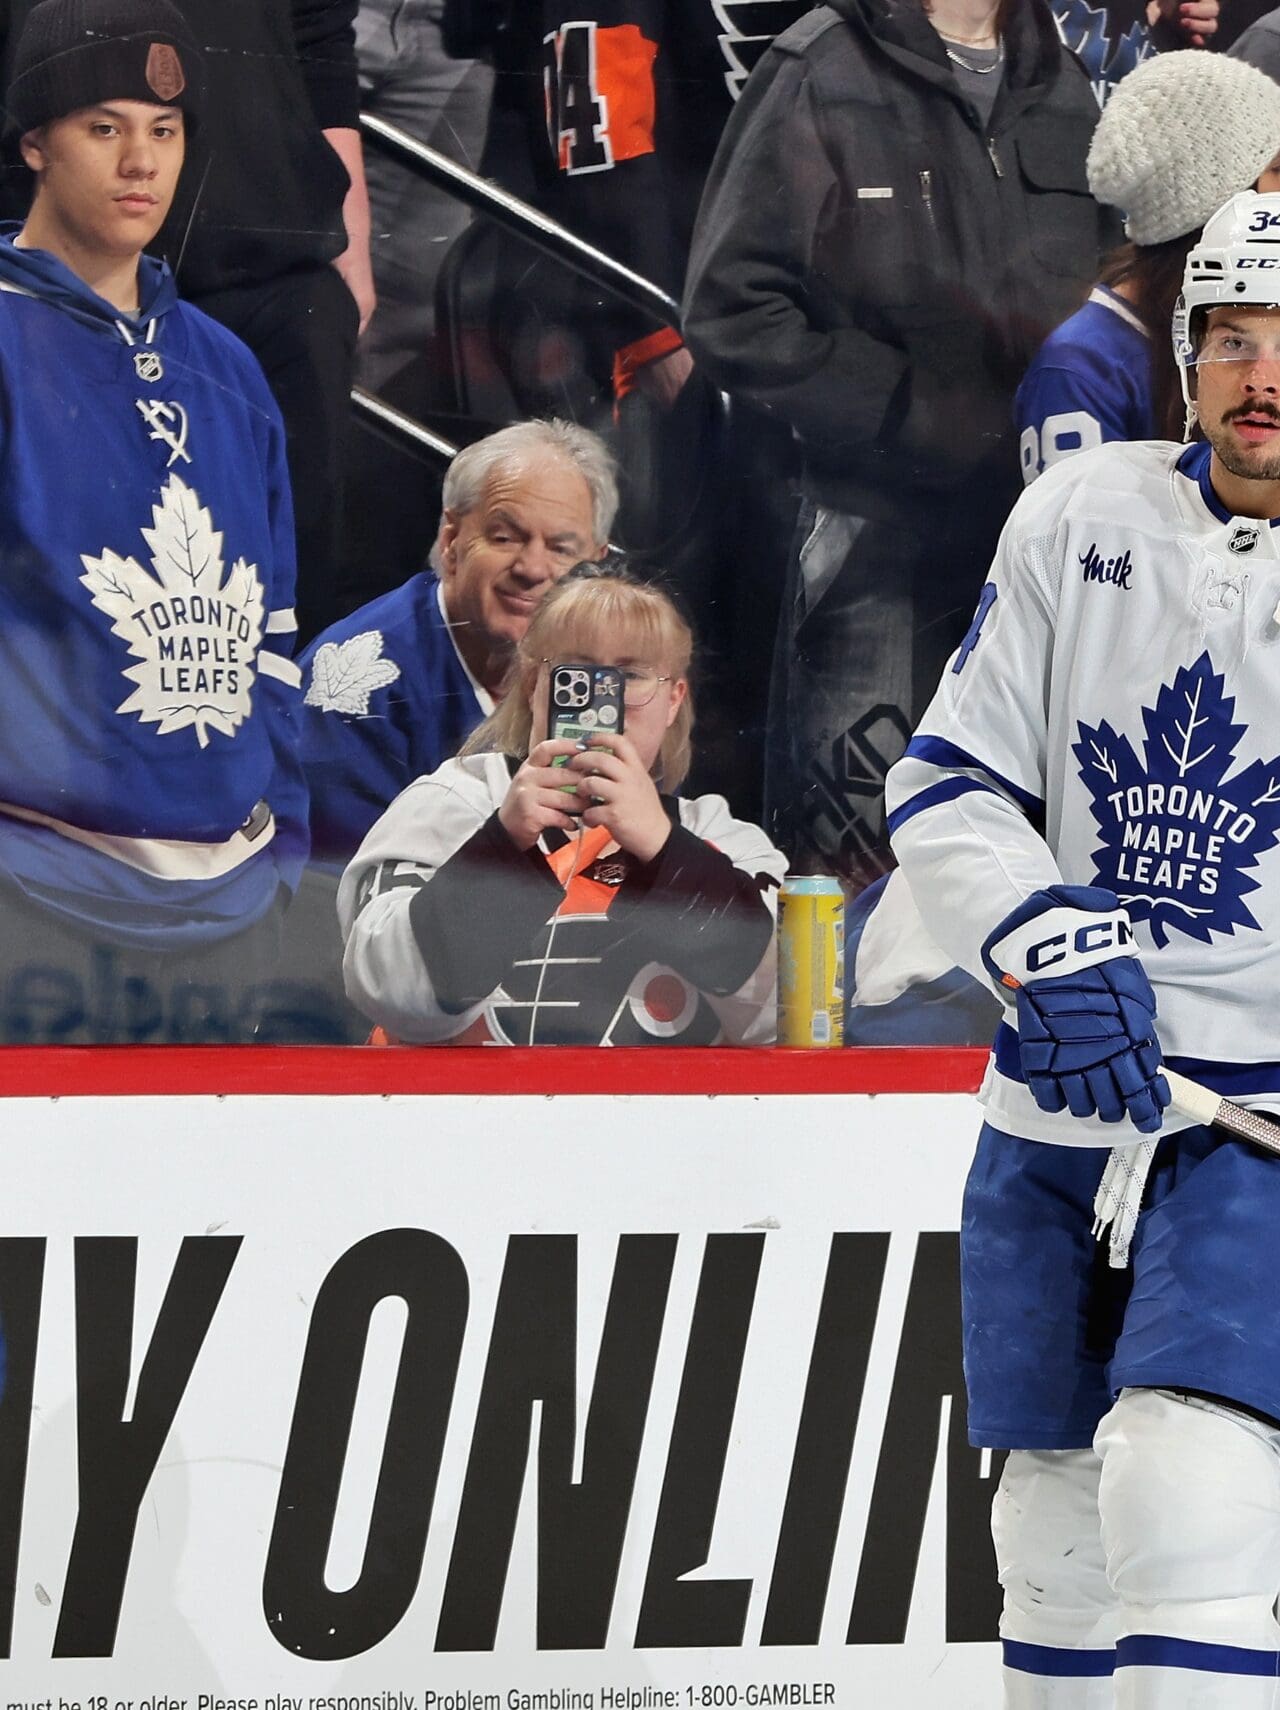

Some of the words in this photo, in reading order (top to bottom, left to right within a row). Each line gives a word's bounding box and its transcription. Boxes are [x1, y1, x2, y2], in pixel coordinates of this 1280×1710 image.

[1078, 543, 1133, 591] Milk
[131, 595, 250, 643] TORONTO
[158, 636, 239, 663] MAPLE
[160, 666, 239, 695] LEAFS
[1107, 783, 1257, 844] TORONTO
[1122, 820, 1226, 863] MAPLE
[1116, 852, 1219, 895] LEAFS
[198, 1694, 258, 1710] Please
[424, 1690, 501, 1710] Problem
[507, 1686, 594, 1710] Gambling
[601, 1684, 680, 1710] Helpline:
[686, 1683, 836, 1707] 1-800-GAMBLER
